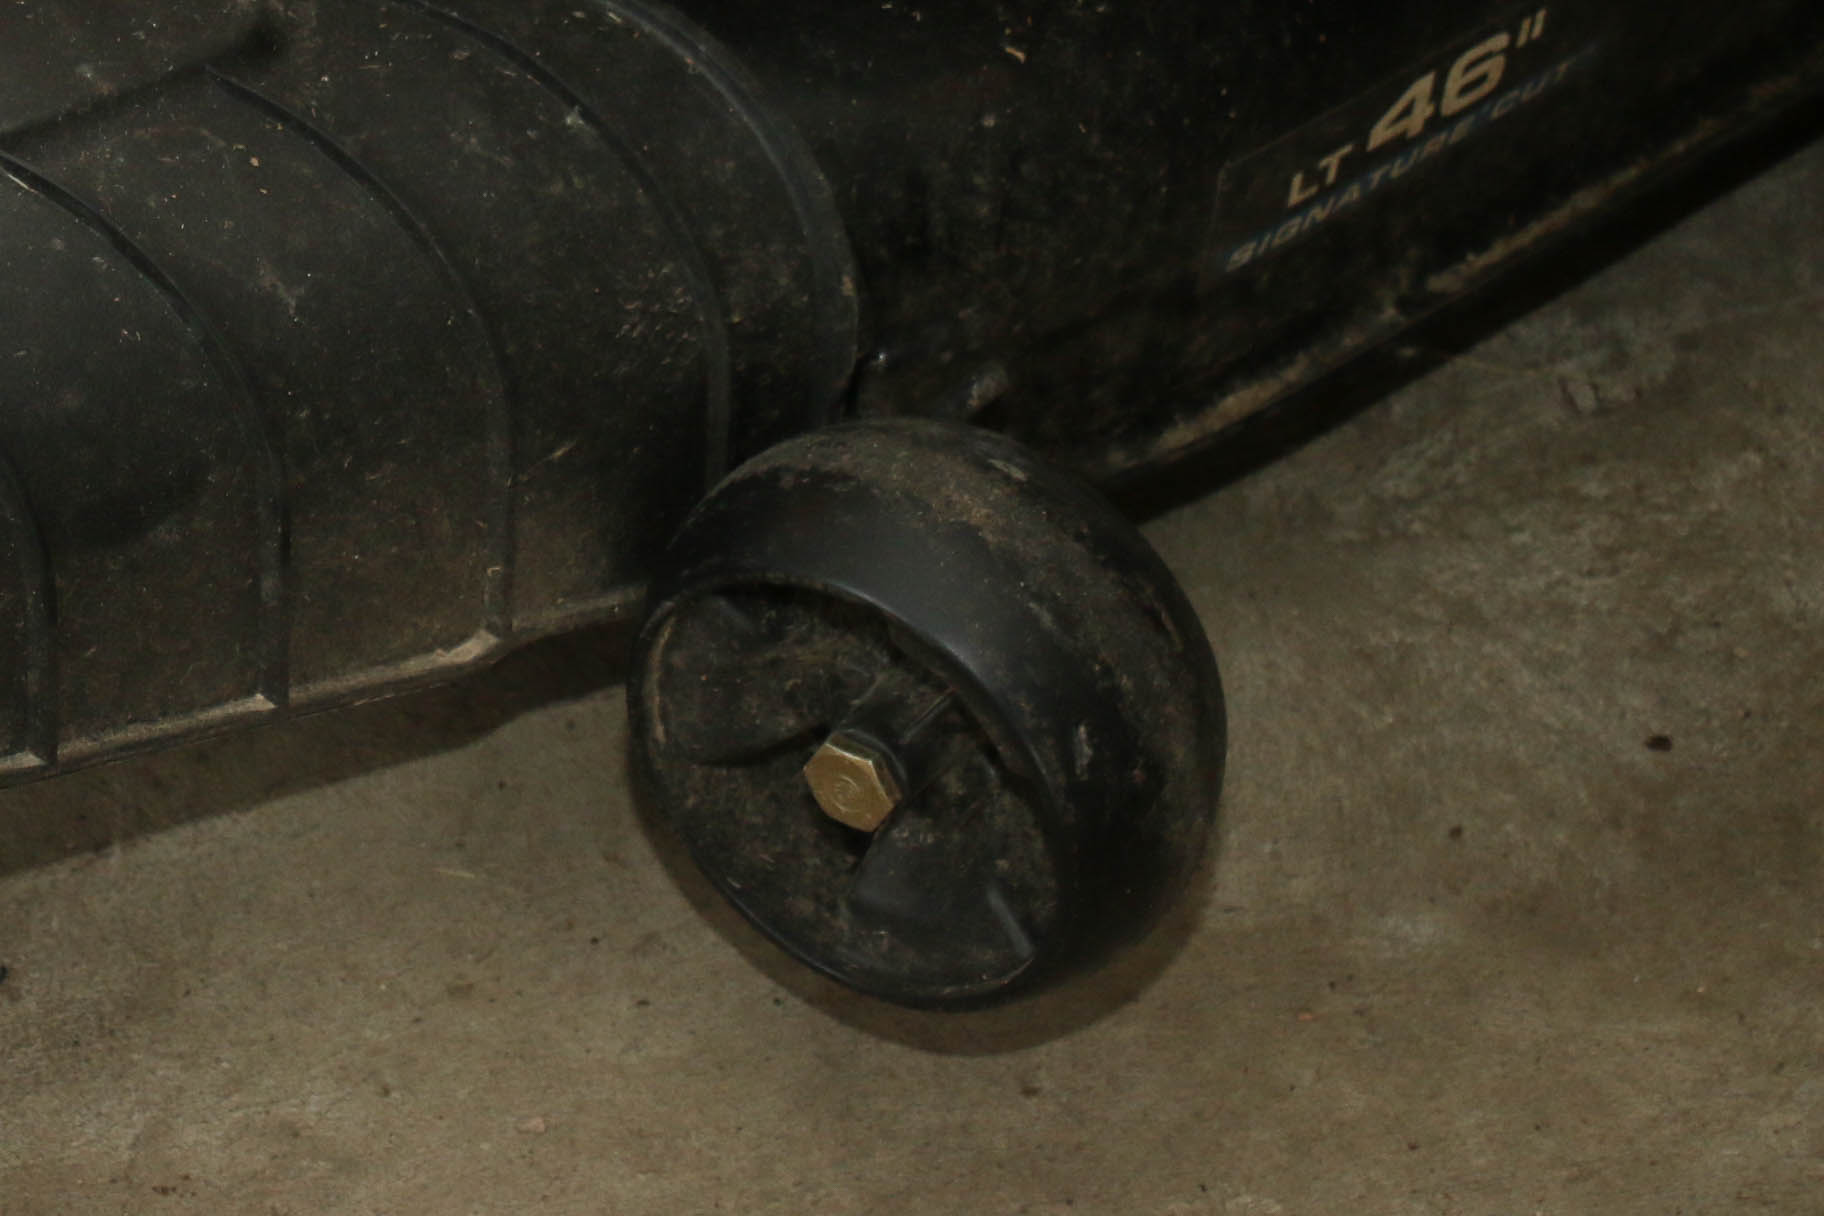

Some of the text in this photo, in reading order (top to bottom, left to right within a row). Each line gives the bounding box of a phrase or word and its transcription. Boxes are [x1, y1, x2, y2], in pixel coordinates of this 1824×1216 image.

[1224, 60, 1572, 273] SIGNATURE CUT
[1287, 142, 1357, 209] LT
